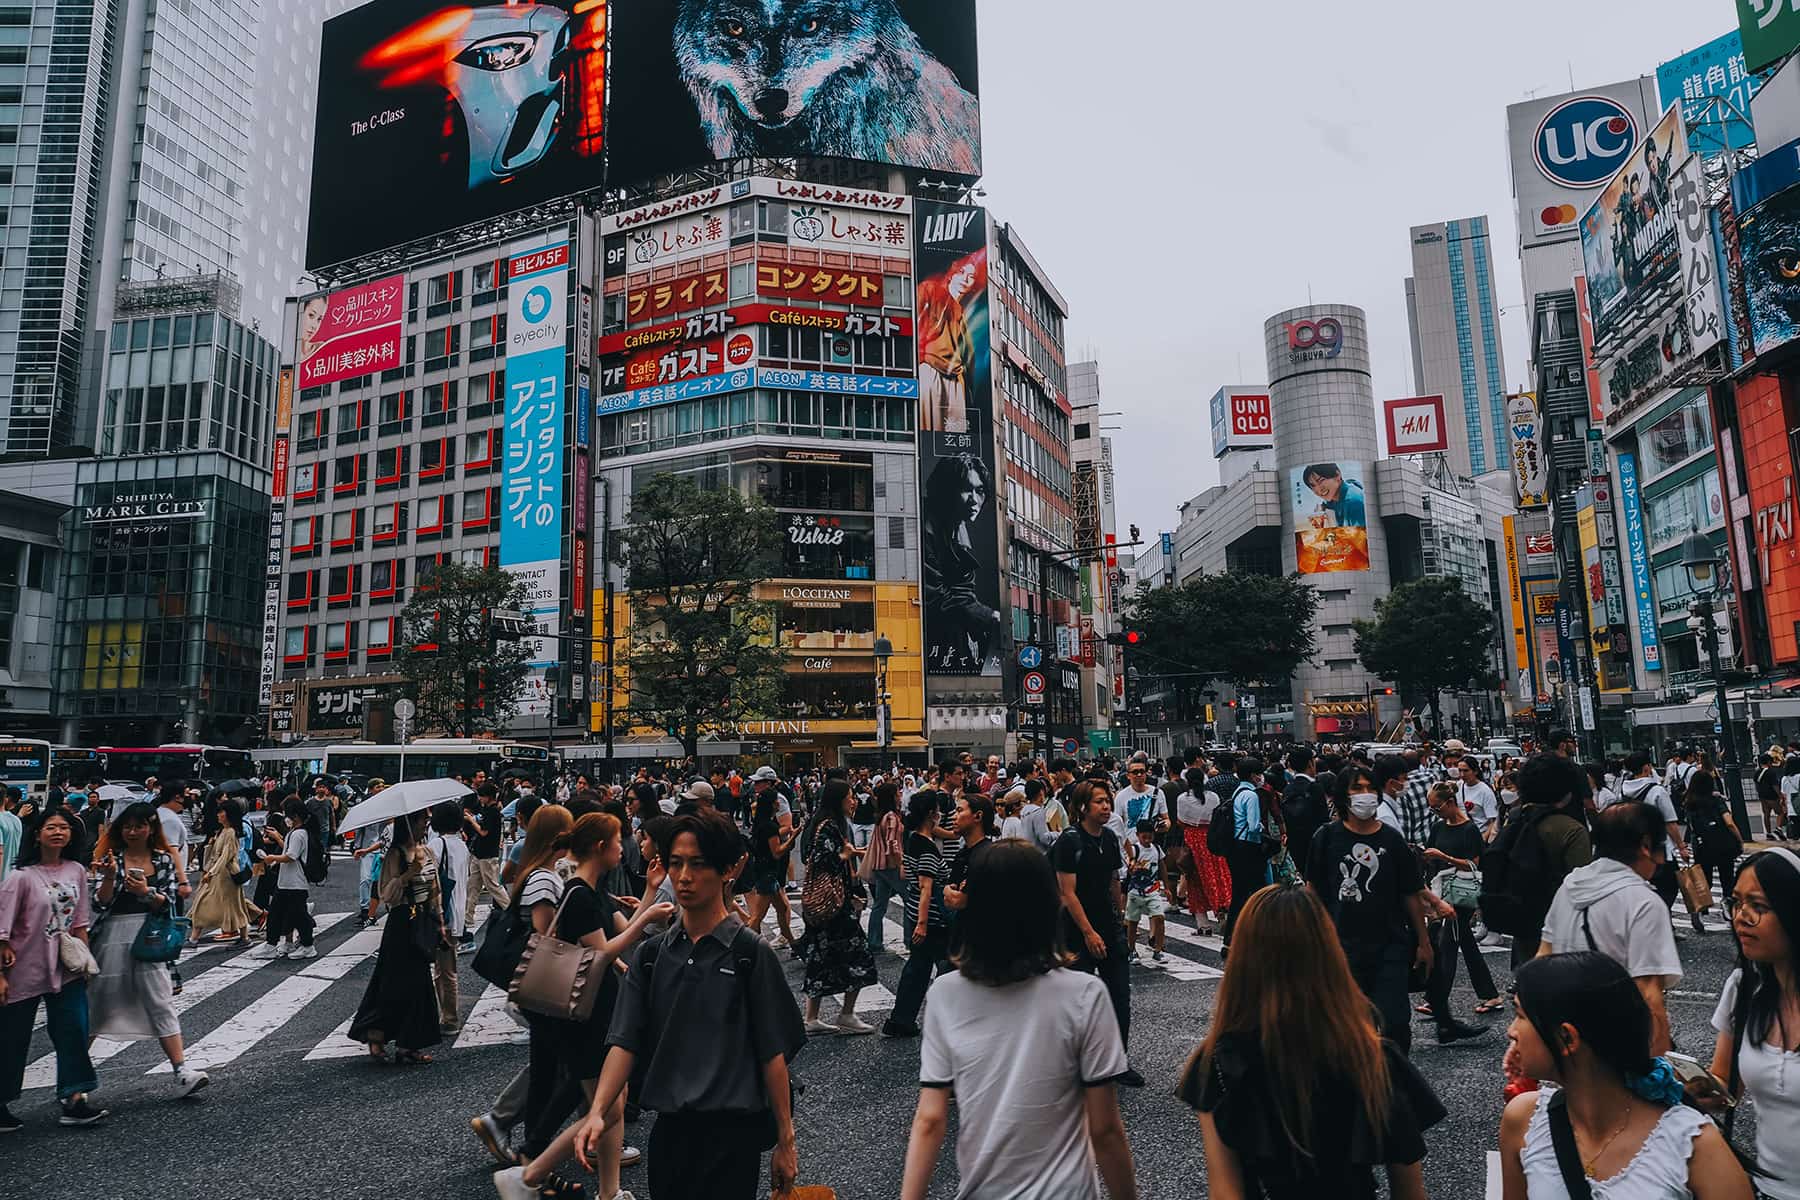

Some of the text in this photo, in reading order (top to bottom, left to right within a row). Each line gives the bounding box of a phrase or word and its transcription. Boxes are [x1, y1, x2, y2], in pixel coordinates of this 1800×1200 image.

[351, 107, 405, 137] The C-Class
[1545, 115, 1628, 166] UC
[777, 180, 906, 209] しゃぶしゃぶバイキング
[616, 188, 721, 229] しゃぶしゃぶバイキング
[662, 216, 723, 252] しゃぶ葉
[832, 215, 905, 246] しゃぶ葉
[514, 250, 563, 274] 当ビル5F
[607, 248, 625, 265] 9F
[628, 273, 726, 316] プライス
[758, 266, 879, 298] コンタクト
[345, 285, 399, 311] 品川スキン
[345, 304, 392, 329] クリニック
[685, 311, 735, 341] ガスト
[844, 312, 900, 338] ガスト
[513, 323, 559, 345] eyecity
[1283, 317, 1344, 359] 109
[312, 340, 396, 378] 品川美容外科
[730, 346, 751, 358] ガスト
[1289, 350, 1325, 362] SHIBUYA
[603, 366, 625, 386] 7F
[630, 359, 657, 376] Café
[658, 347, 719, 383] ガスト
[600, 395, 630, 410] AEON
[638, 376, 727, 405] 英会話イーオン
[763, 371, 915, 395] AEON 英会話イーオン
[1235, 399, 1265, 414] UNI
[1236, 416, 1269, 433] QLO
[1400, 414, 1430, 435] H&M
[536, 374, 558, 527] コンタクトの
[943, 434, 971, 448] 玄師
[508, 379, 538, 530] アイシティ
[86, 501, 208, 519] MARK CITY
[115, 493, 174, 503] SHIBUYA
[788, 526, 845, 545] Ushi8
[1623, 476, 1647, 589] サマーフルーツギフト
[1756, 475, 1794, 585] クスリ
[804, 657, 832, 670] Café
[1062, 669, 1079, 690] LUSH
[285, 694, 295, 704] 2F
